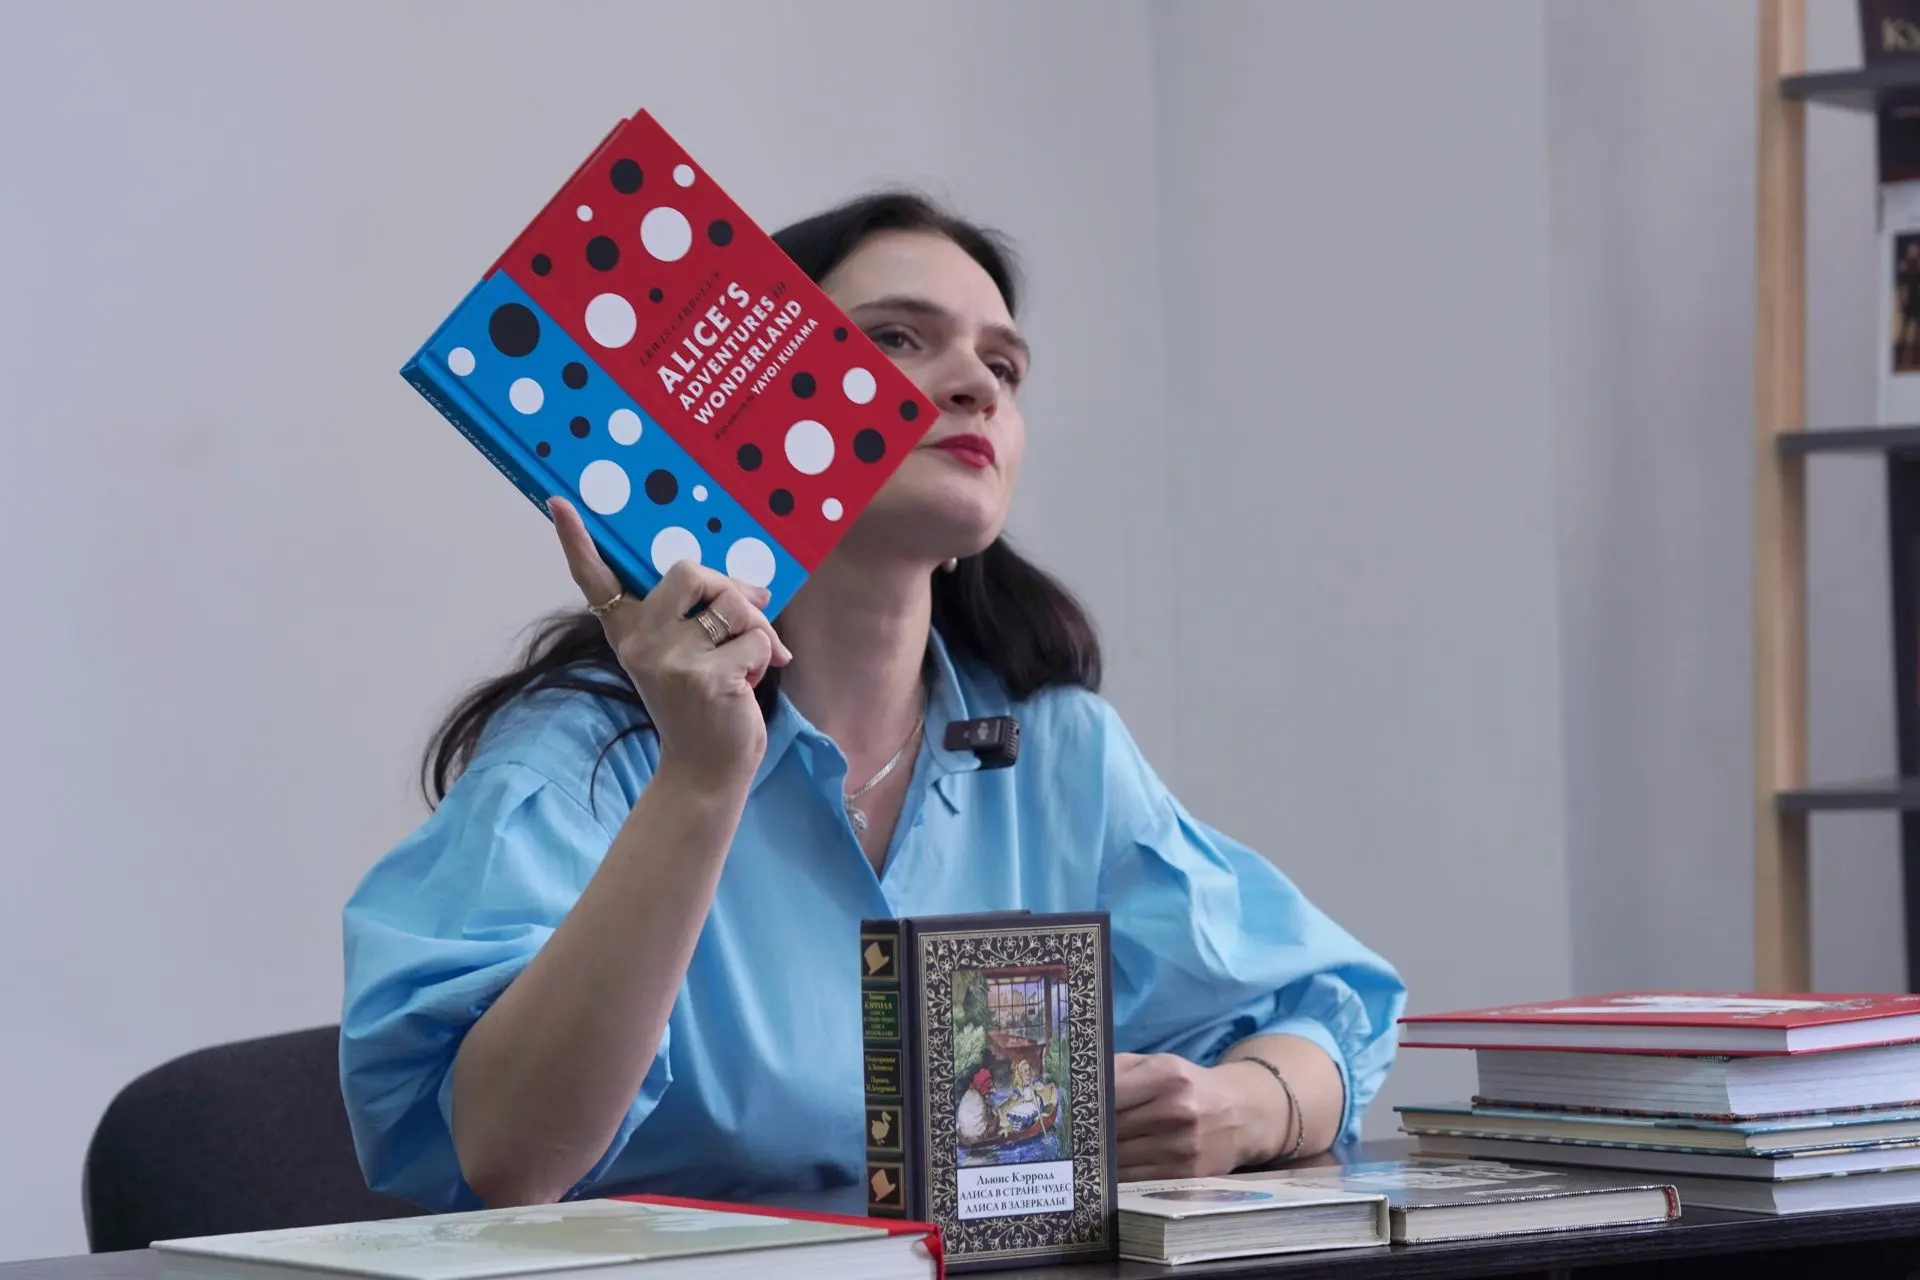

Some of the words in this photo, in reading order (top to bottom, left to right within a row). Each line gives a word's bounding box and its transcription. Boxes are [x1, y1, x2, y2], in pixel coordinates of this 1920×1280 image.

[657, 281, 750, 394] ALICE'S
[678, 295, 776, 411] ADVENTURES
[693, 299, 803, 426] WONDERLAND
[750, 360, 782, 396] YAYOI
[777, 318, 819, 363] KUSAMA
[452, 419, 519, 483] ADVENTURES
[960, 1190, 994, 1201] АЛИСА
[995, 1189, 1002, 1198] В
[1002, 1185, 1041, 1197] СТРАНЕ
[1041, 1182, 1072, 1194] ЧУДЕС
[966, 1202, 999, 1214] АЛИСА
[1001, 1201, 1007, 1210] В
[1008, 1196, 1067, 1210] ЗАЗЕРКАЛЬЕ
[977, 1172, 1010, 1186] Льюис
[1012, 1171, 1055, 1185] Кэрролл
